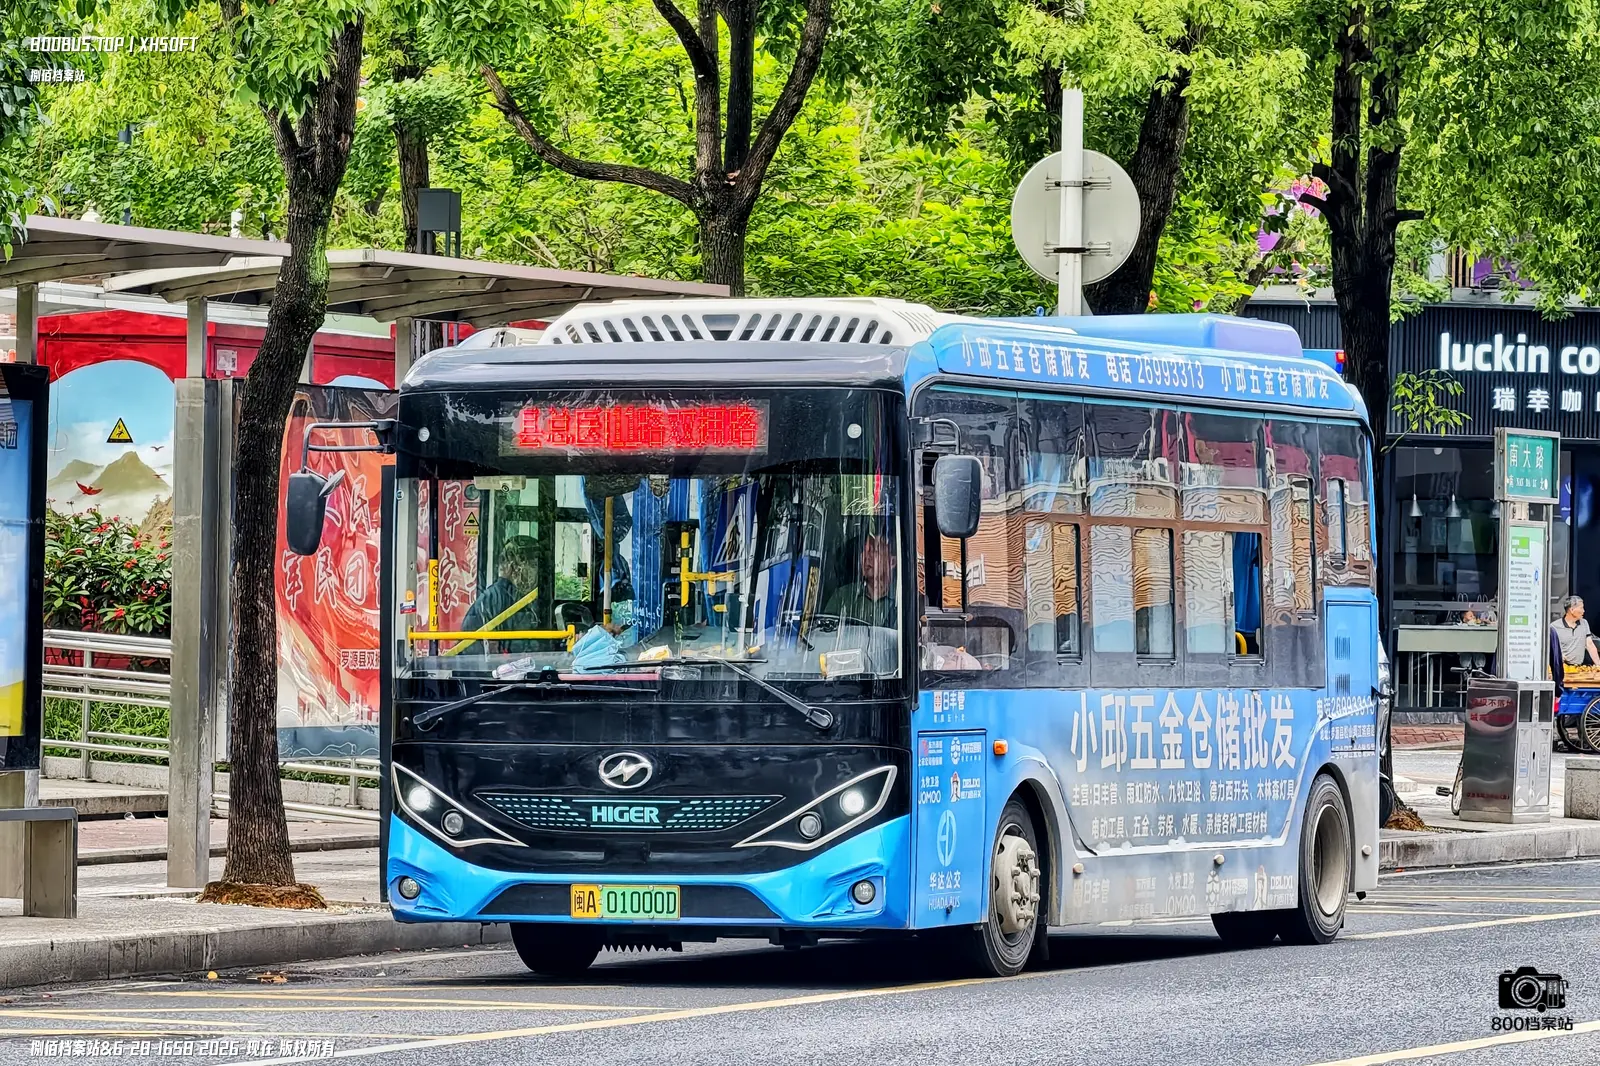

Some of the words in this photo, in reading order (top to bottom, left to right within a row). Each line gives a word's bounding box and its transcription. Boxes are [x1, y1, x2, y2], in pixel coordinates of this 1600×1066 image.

[1440, 332, 1550, 373] luckin
[962, 334, 1091, 380] 小邱五金仓储批发
[1135, 356, 1204, 390] 26993313
[1220, 362, 1330, 400] 小邱五金仓储批发
[1492, 387, 1600, 413] 瑞幸咖
[1509, 442, 1544, 469] 南大路
[1070, 691, 1296, 773] 小邱五金仓储批发
[592, 806, 660, 823] HIGER
[929, 870, 961, 891] 华达公交
[574, 890, 597, 914] 闽A
[606, 890, 677, 915] 01000D
